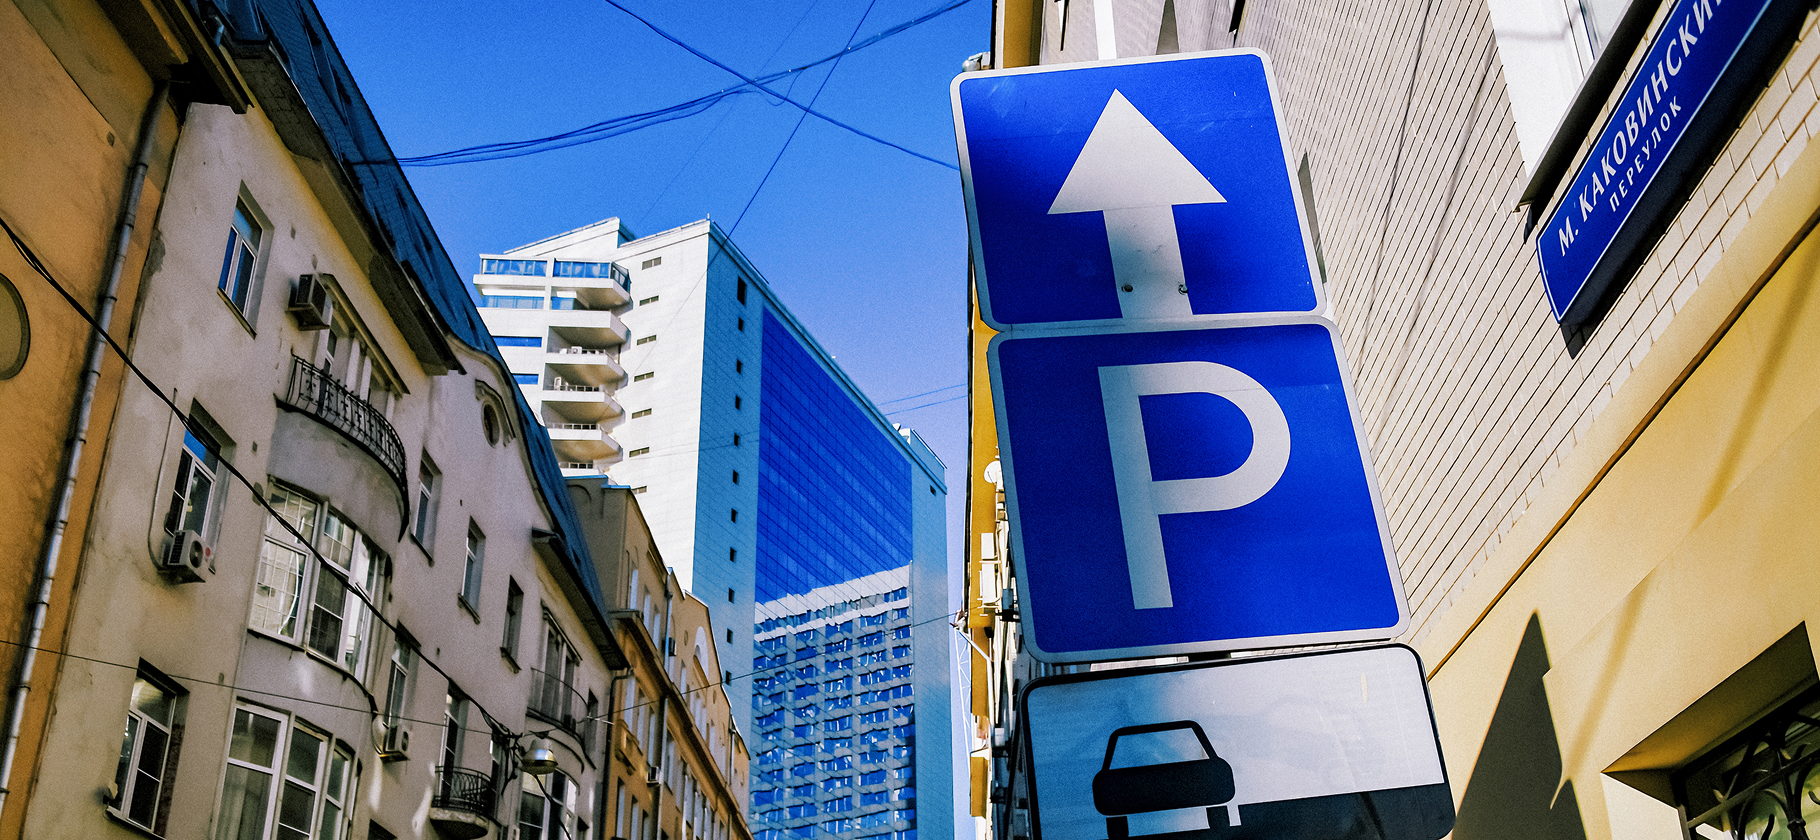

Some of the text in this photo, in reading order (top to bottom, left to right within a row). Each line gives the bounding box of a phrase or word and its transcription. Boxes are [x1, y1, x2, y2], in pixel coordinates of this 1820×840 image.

[1558, 0, 1722, 257] М. КАКОВИНСКИ
[1609, 96, 1682, 212] ПЕРЕУЛОК
[1098, 361, 1291, 610] P
